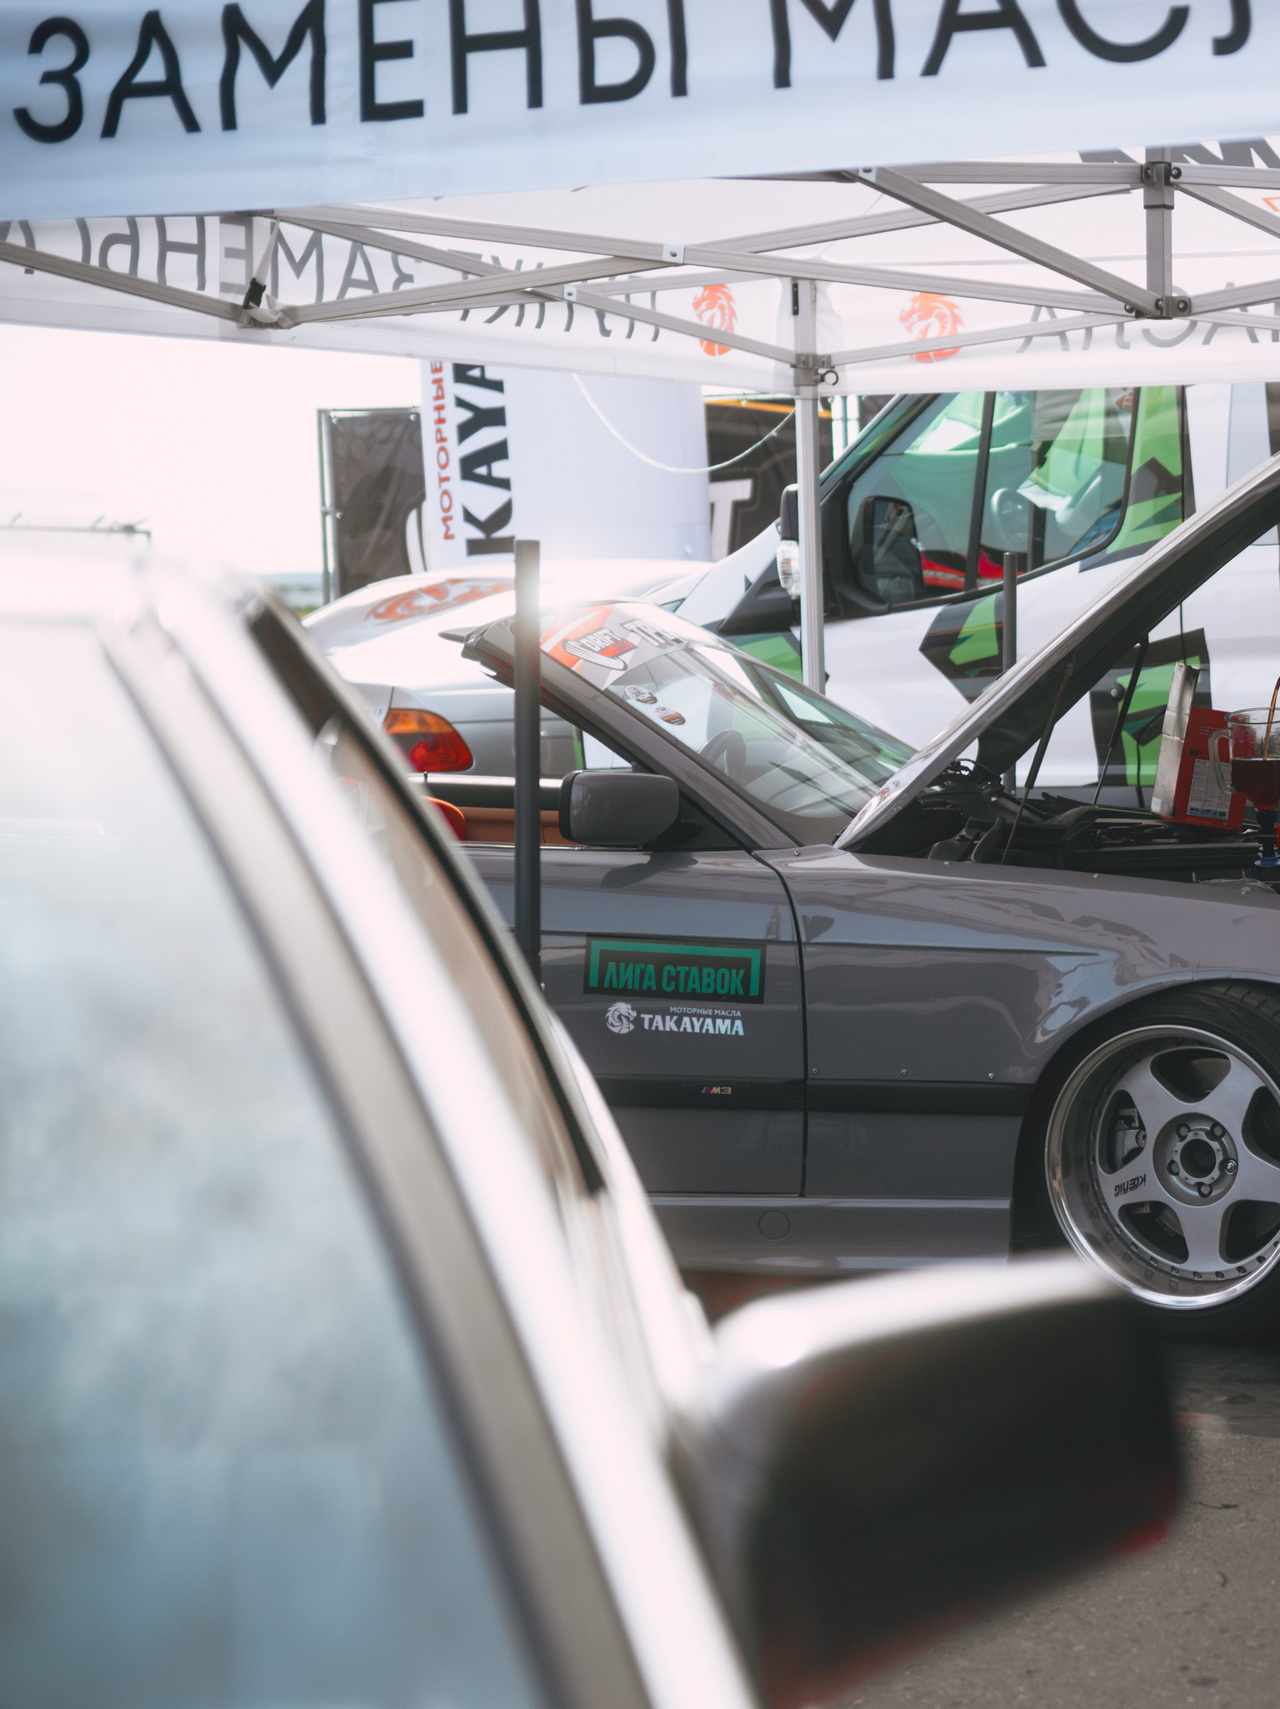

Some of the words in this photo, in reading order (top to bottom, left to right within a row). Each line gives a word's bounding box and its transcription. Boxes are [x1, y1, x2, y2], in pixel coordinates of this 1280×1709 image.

[13, 0, 689, 143] ЗАМЕНЫ
[603, 961, 657, 991] ЛИГА
[661, 965, 746, 995] СТАВОК
[640, 1013, 745, 1036] TAKAYAMA
[669, 1006, 713, 1016] МОТОРНЫЕ
[714, 1007, 742, 1017] МАСЛА
